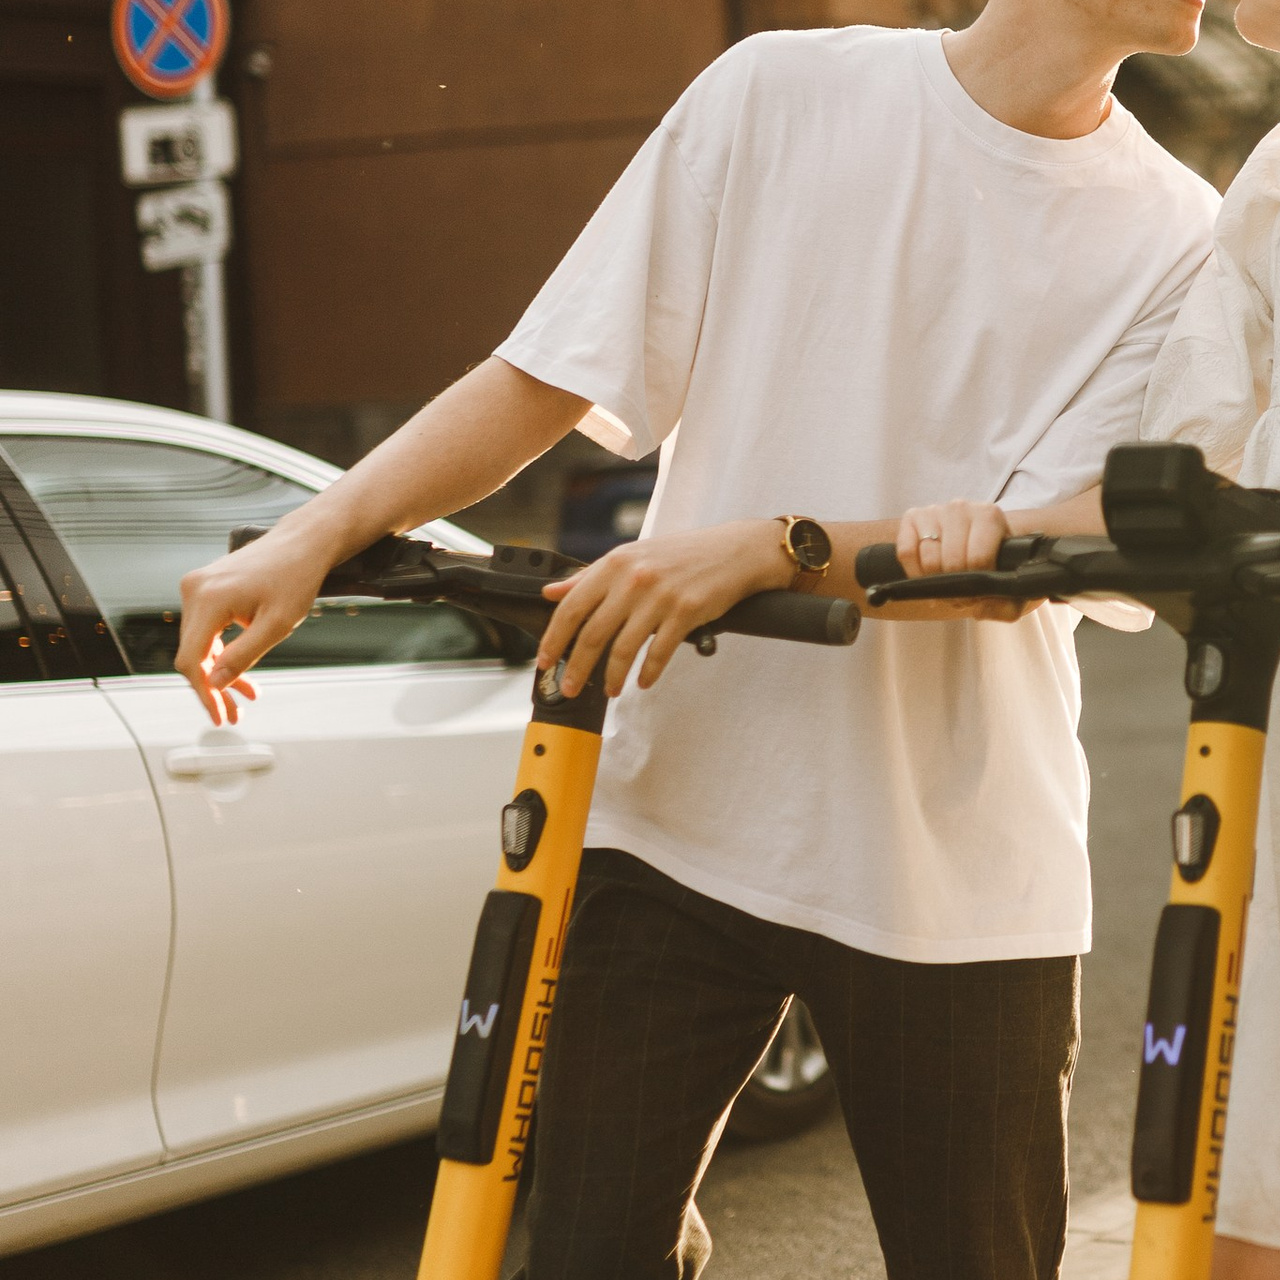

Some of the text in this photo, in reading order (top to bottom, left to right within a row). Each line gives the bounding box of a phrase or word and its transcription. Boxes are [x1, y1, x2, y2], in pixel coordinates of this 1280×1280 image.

[459, 998, 499, 1039] W
[1144, 1022, 1187, 1066] W
[503, 978, 557, 1182] WHOOSH
